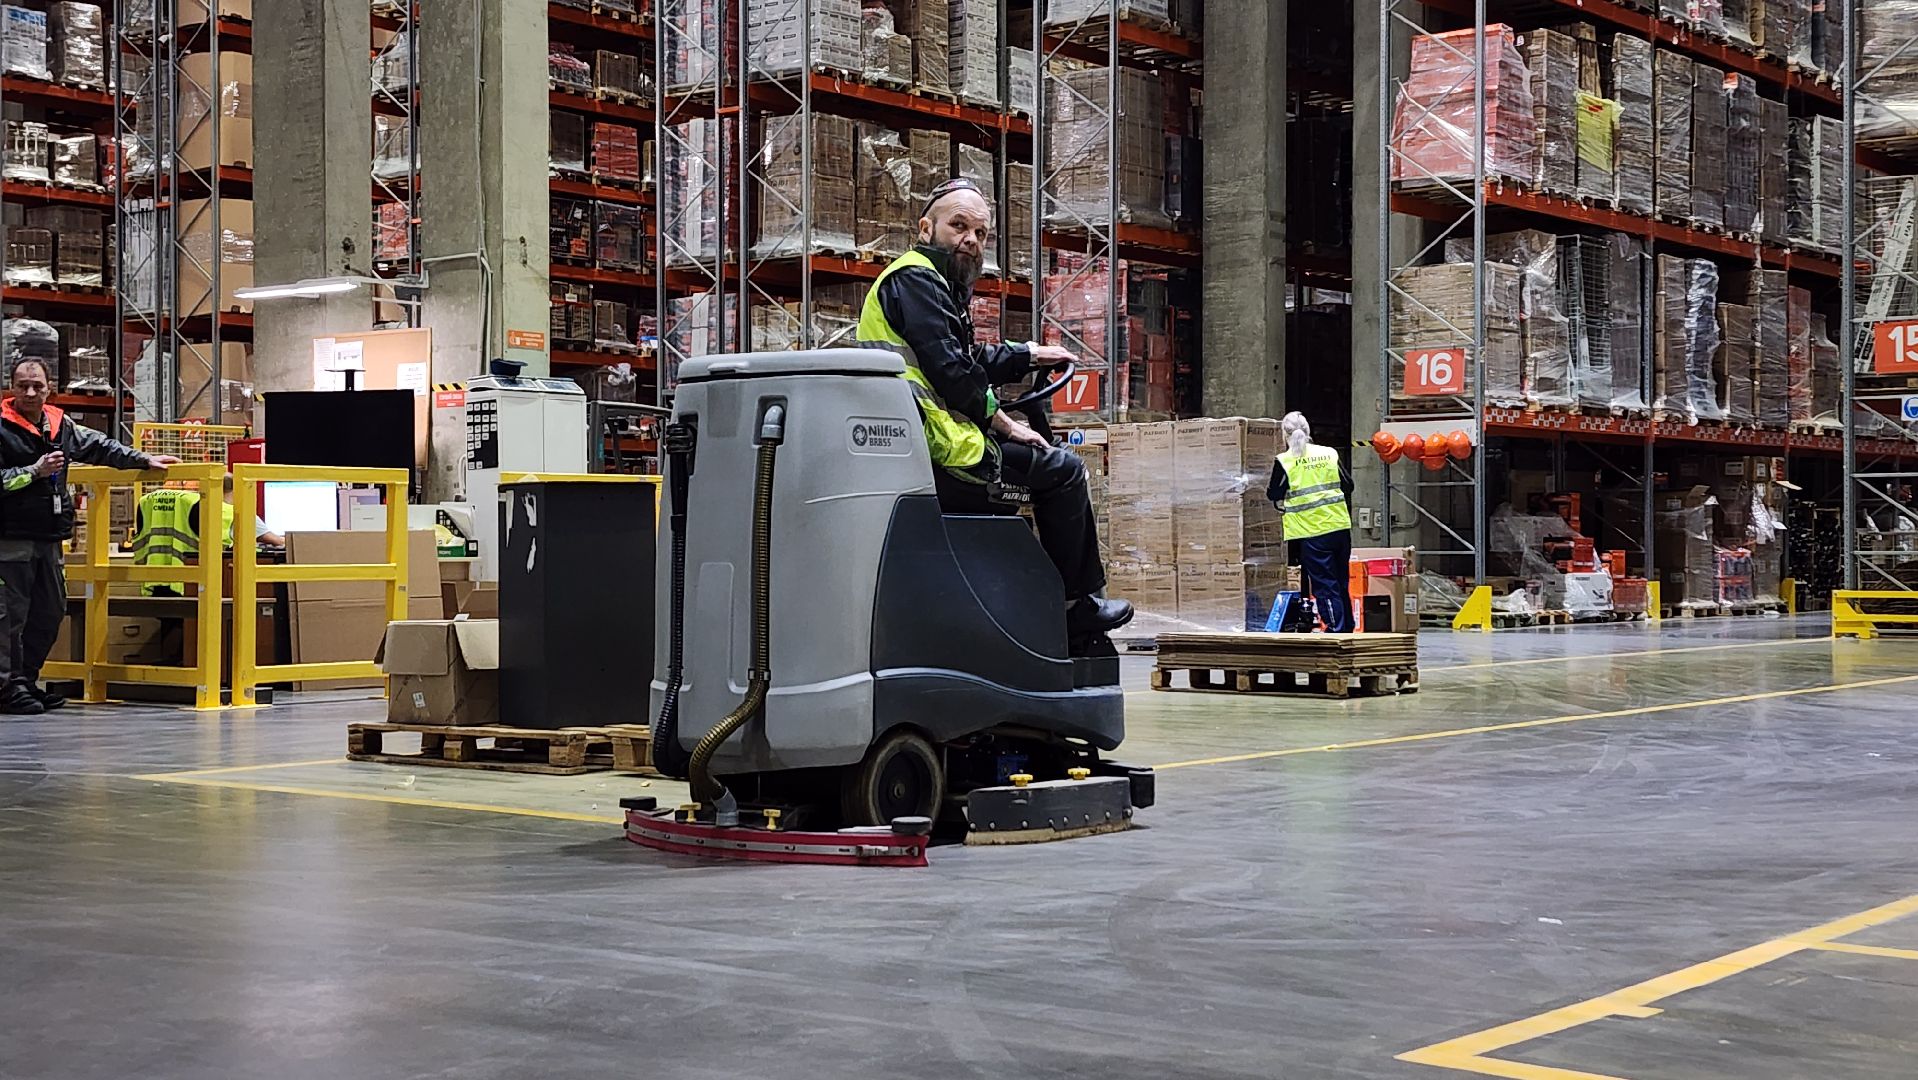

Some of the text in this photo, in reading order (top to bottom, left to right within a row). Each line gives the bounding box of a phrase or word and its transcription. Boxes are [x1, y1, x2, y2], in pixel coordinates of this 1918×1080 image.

[1416, 352, 1453, 386] 16
[1065, 374, 1089, 405] 17
[868, 424, 907, 438] Nilfisk
[1001, 492, 1030, 502] PATRIOT
